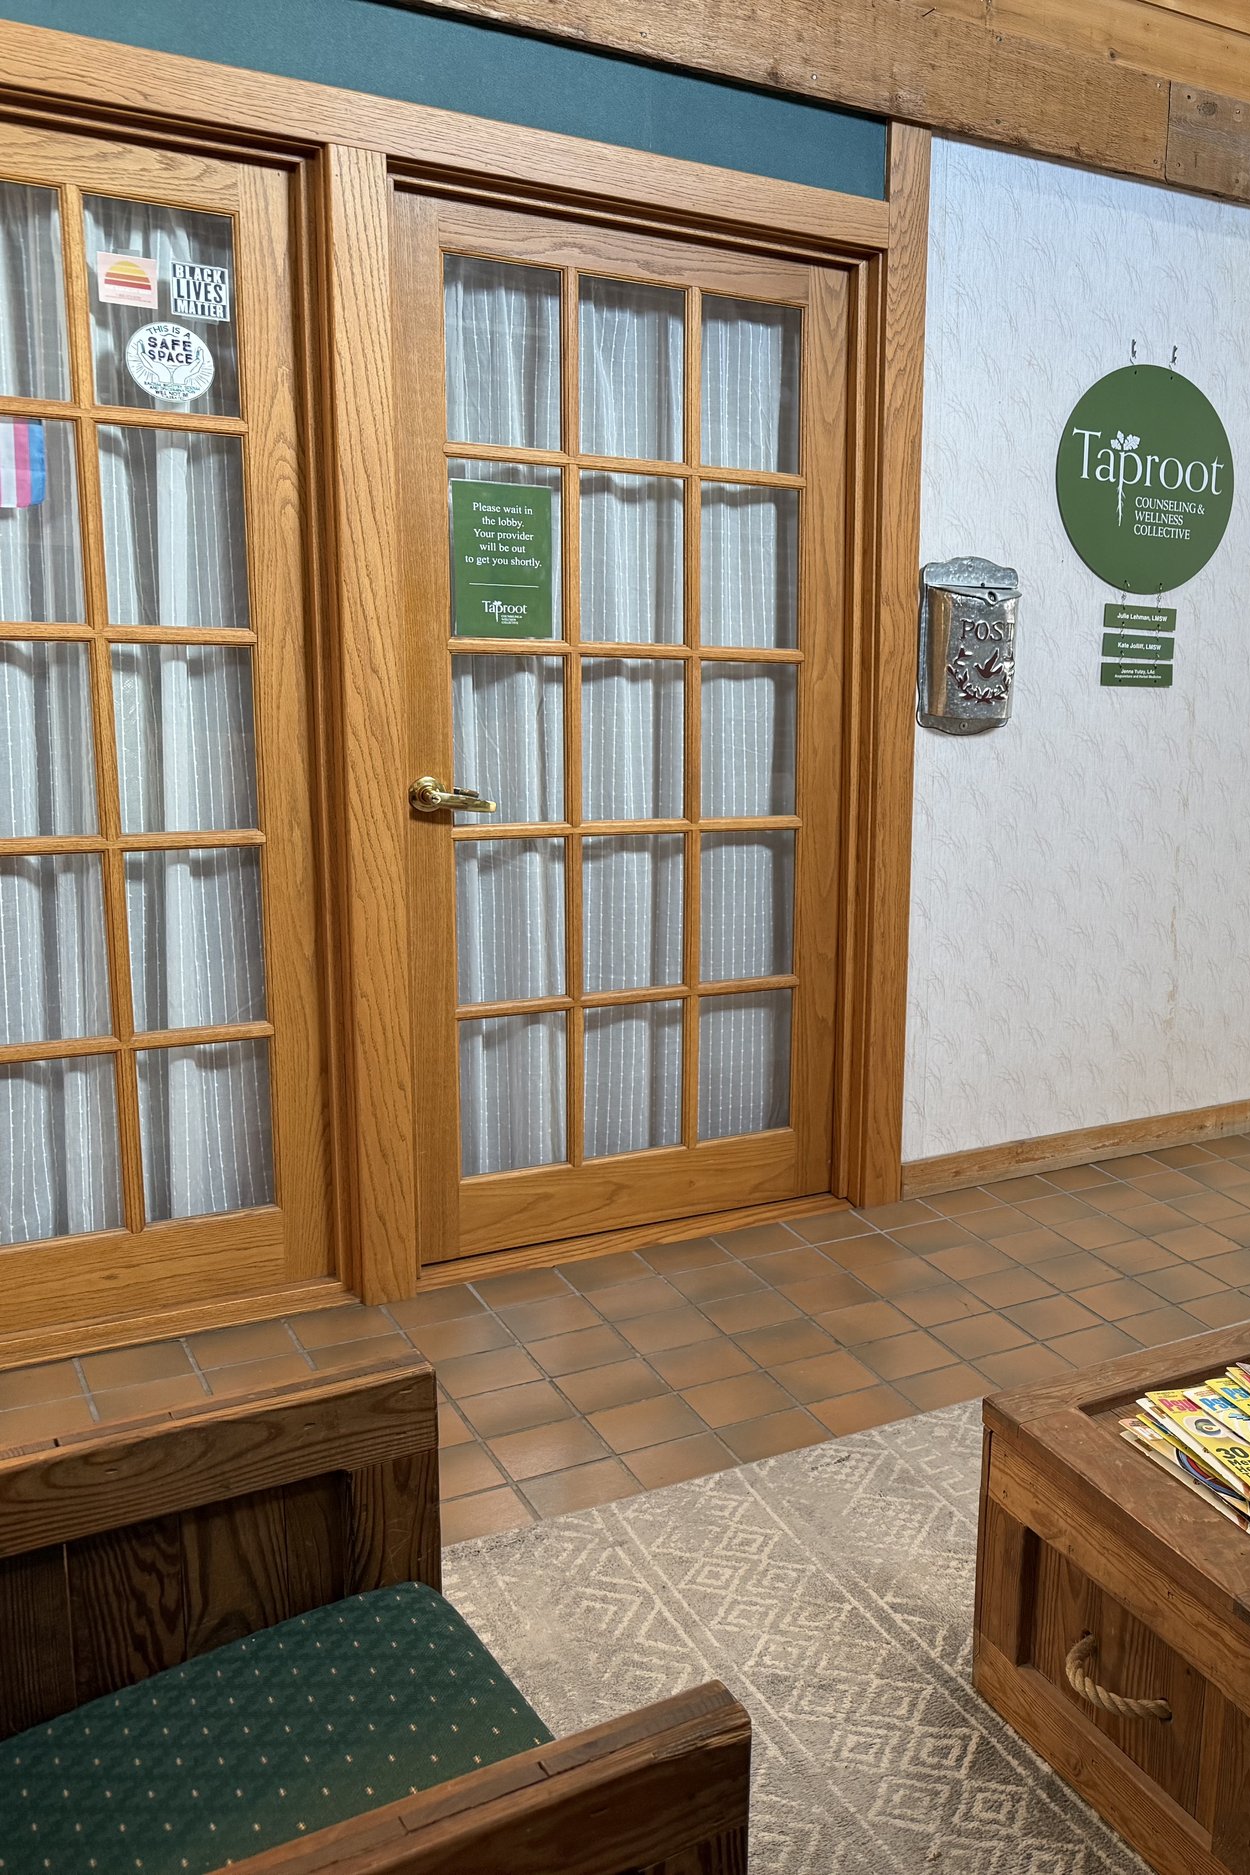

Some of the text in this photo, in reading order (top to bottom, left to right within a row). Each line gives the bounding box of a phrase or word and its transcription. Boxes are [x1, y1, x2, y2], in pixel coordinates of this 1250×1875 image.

[174, 263, 223, 284] BLACK
[176, 279, 223, 304] LIVES
[176, 299, 225, 319] MATTER
[146, 325, 192, 340] THIS IS A
[147, 336, 193, 352] SAFE
[147, 349, 193, 365] SPACE
[1072, 427, 1225, 511] Taproot
[472, 501, 533, 515] Please wait in
[1134, 496, 1206, 515] COUNSELING &
[481, 515, 525, 530] the lobby.
[1134, 510, 1184, 526] WELLNESS
[473, 528, 534, 541] Your provider
[1133, 523, 1191, 540] COLLECTIVE
[479, 542, 526, 553] will be out
[464, 555, 542, 569] to get you shortly.
[481, 600, 528, 618] Taproot
[959, 617, 1014, 641] POST
[1216, 1446, 1250, 1460] 30
